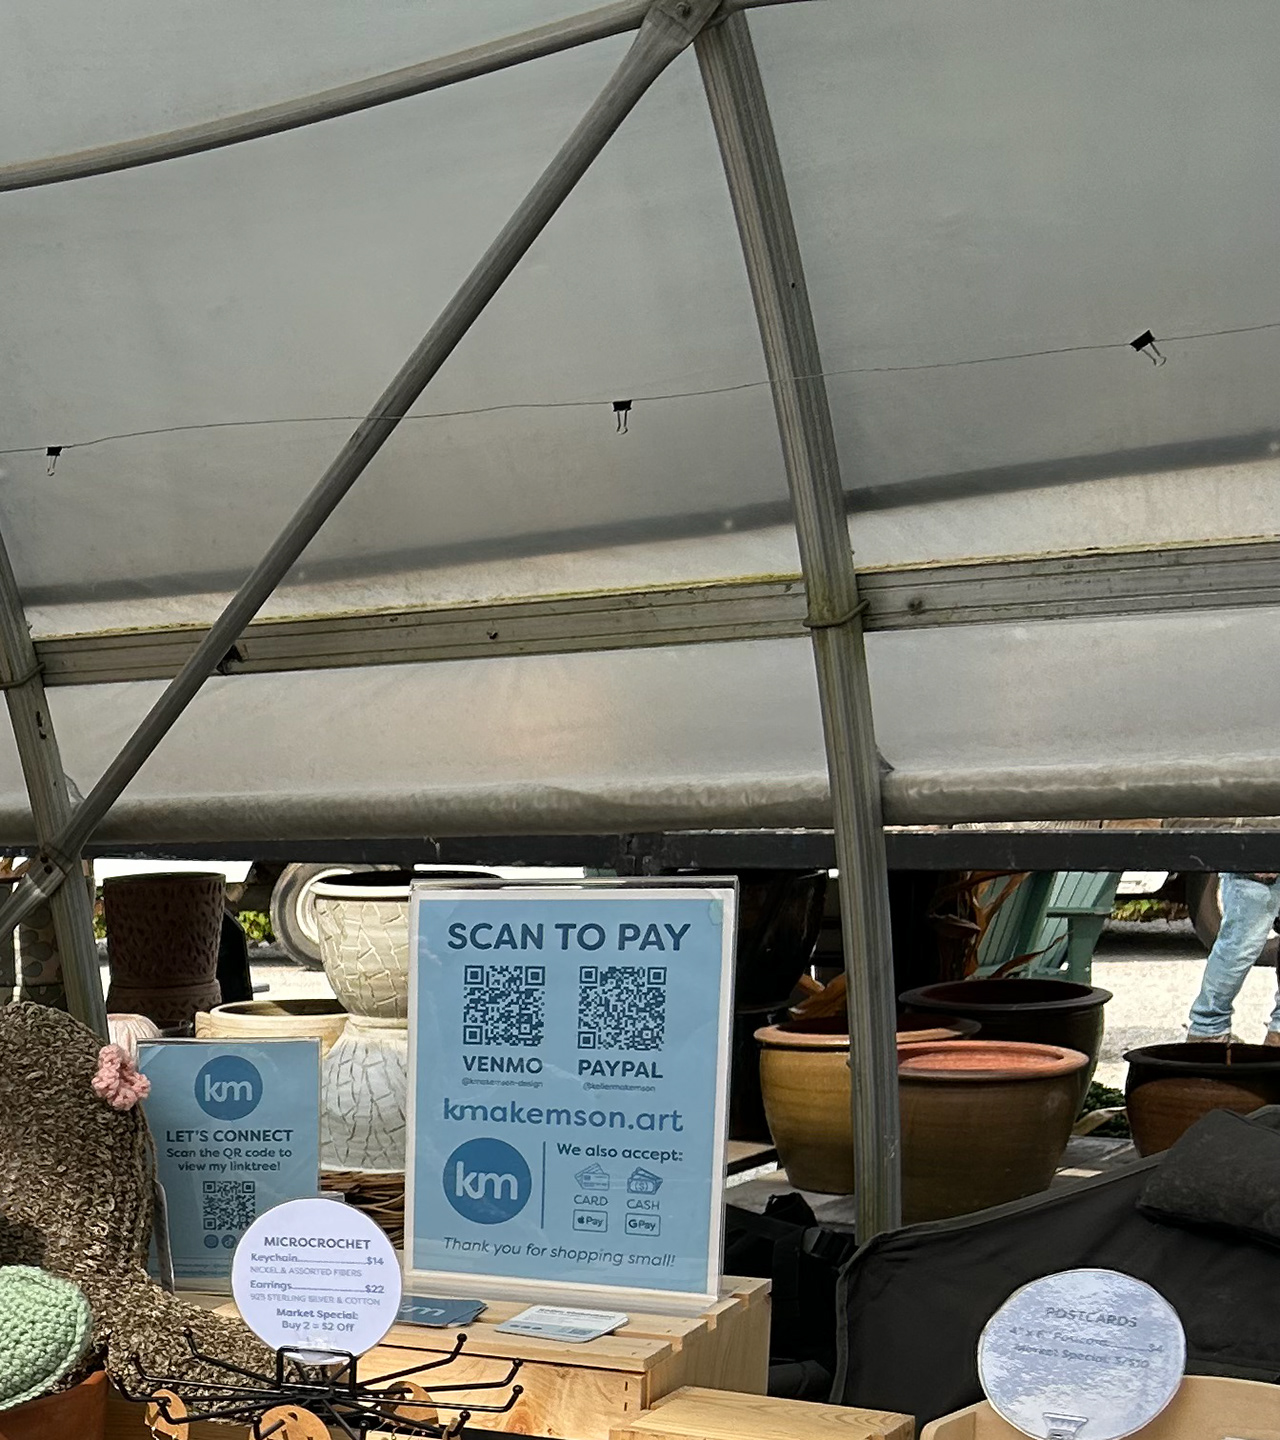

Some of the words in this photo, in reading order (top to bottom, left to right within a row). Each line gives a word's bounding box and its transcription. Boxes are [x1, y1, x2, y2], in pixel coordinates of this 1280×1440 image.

[447, 922, 544, 951] SCAN
[554, 923, 607, 952] TO
[617, 923, 692, 952] PAY
[462, 1055, 543, 1074] VENMO
[578, 1059, 664, 1079] PAYPAL
[204, 1073, 253, 1102] km
[443, 1097, 684, 1132] kmakemson.art
[166, 1130, 209, 1143] LET'S
[212, 1129, 294, 1142] CONNECT
[166, 1148, 196, 1158] Scan
[199, 1148, 220, 1158] the
[222, 1147, 243, 1159] QR
[245, 1148, 276, 1158] code
[278, 1148, 293, 1158] to
[556, 1142, 582, 1156] We
[585, 1144, 618, 1158] also
[621, 1148, 684, 1164] accept:
[177, 1161, 207, 1171] view
[208, 1163, 227, 1173] my
[230, 1161, 281, 1171] linktree!
[455, 1160, 519, 1201] km
[573, 1194, 609, 1207] CARD
[626, 1198, 660, 1211] CASH
[585, 1216, 604, 1228] Pay
[263, 1236, 371, 1250] MICROCROCHET
[443, 1236, 490, 1253] Thank
[493, 1243, 522, 1257] you
[526, 1242, 548, 1257] for
[549, 1245, 624, 1267] shopping
[627, 1253, 676, 1268] small!
[366, 1256, 385, 1266] $14
[288, 1267, 333, 1276] ASSORTED
[333, 1268, 363, 1277] FIBERS
[364, 1284, 385, 1294] $22
[344, 1297, 381, 1306] COTTON
[276, 1307, 315, 1318] Market
[1045, 1306, 1138, 1329] POSTCARDS
[281, 1320, 301, 1332] Buy
[302, 1321, 311, 1330] 2
[336, 1322, 355, 1333] Off
